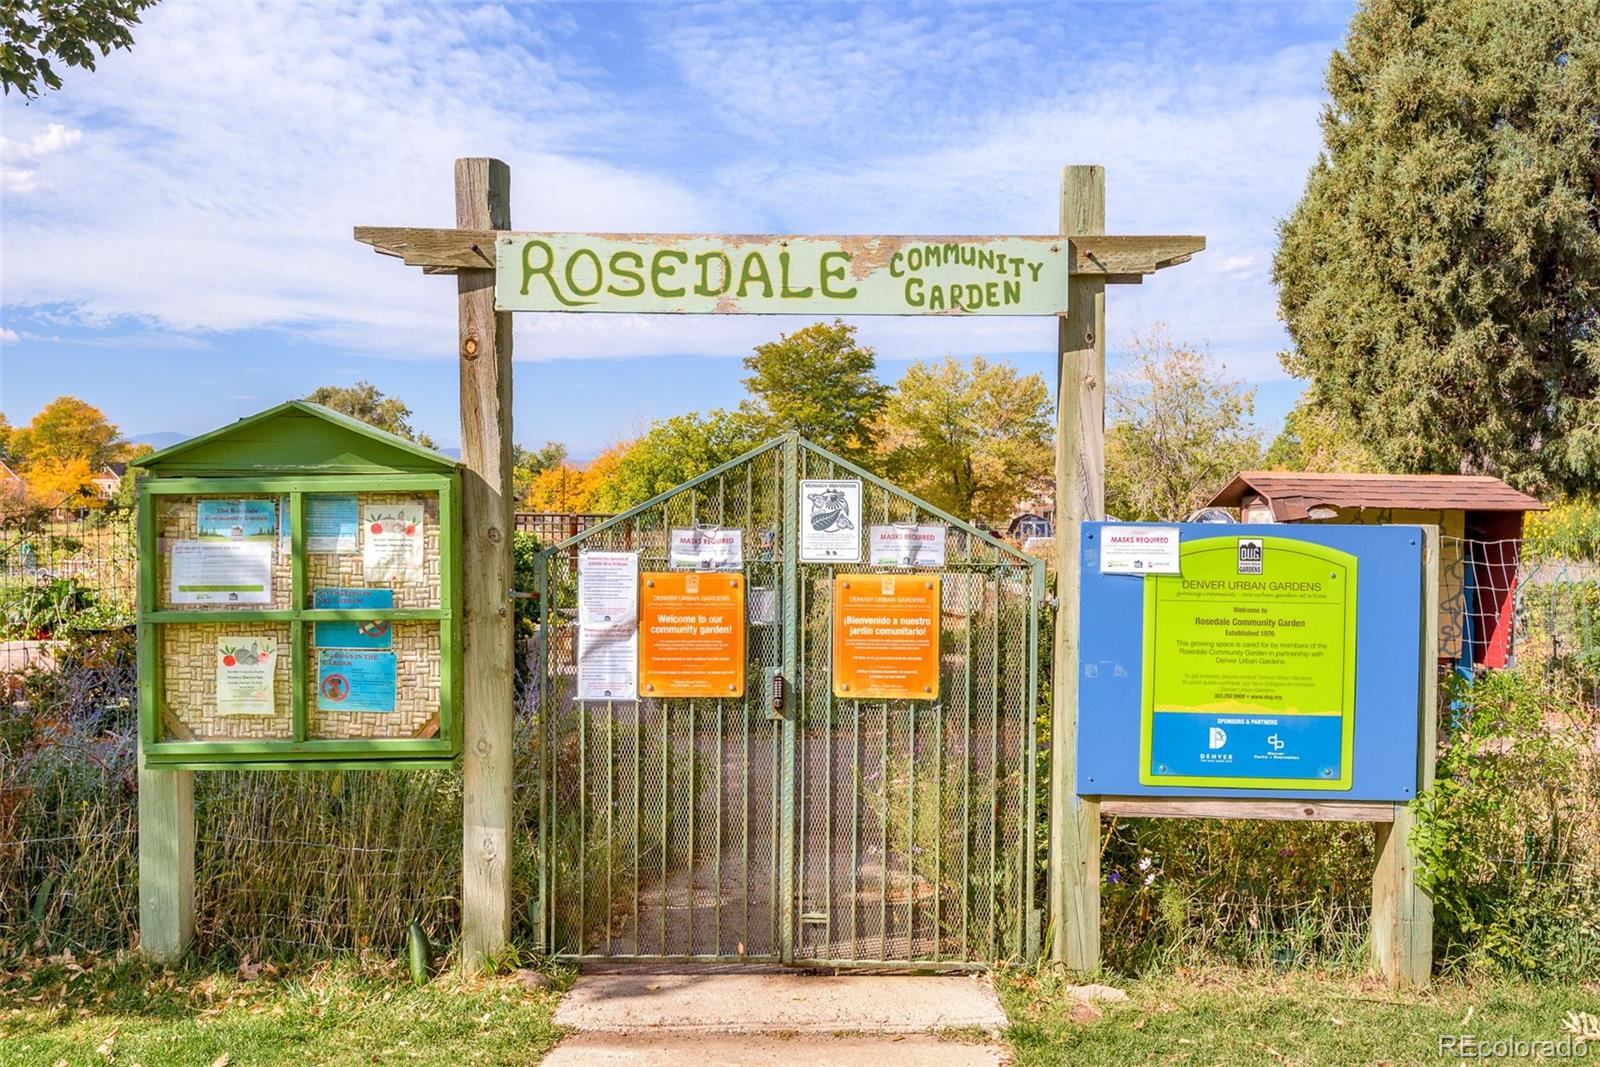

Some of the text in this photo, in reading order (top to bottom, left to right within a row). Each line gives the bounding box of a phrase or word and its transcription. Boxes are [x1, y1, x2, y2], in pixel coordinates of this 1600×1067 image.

[890, 243, 1044, 282] COMMUNITY
[520, 240, 858, 307] ROSEDALE
[905, 277, 1021, 311] GARDEN
[1182, 580, 1322, 591] DENVER URBAN GARDENS
[658, 615, 696, 623] Welcome
[698, 615, 706, 623] to
[844, 616, 890, 625] ¡Bienvenido
[1195, 618, 1305, 627] Rosedale Community Garden
[651, 625, 732, 635] community garden!
[1209, 648, 1243, 656] Community
[1276, 650, 1310, 658] partnership
